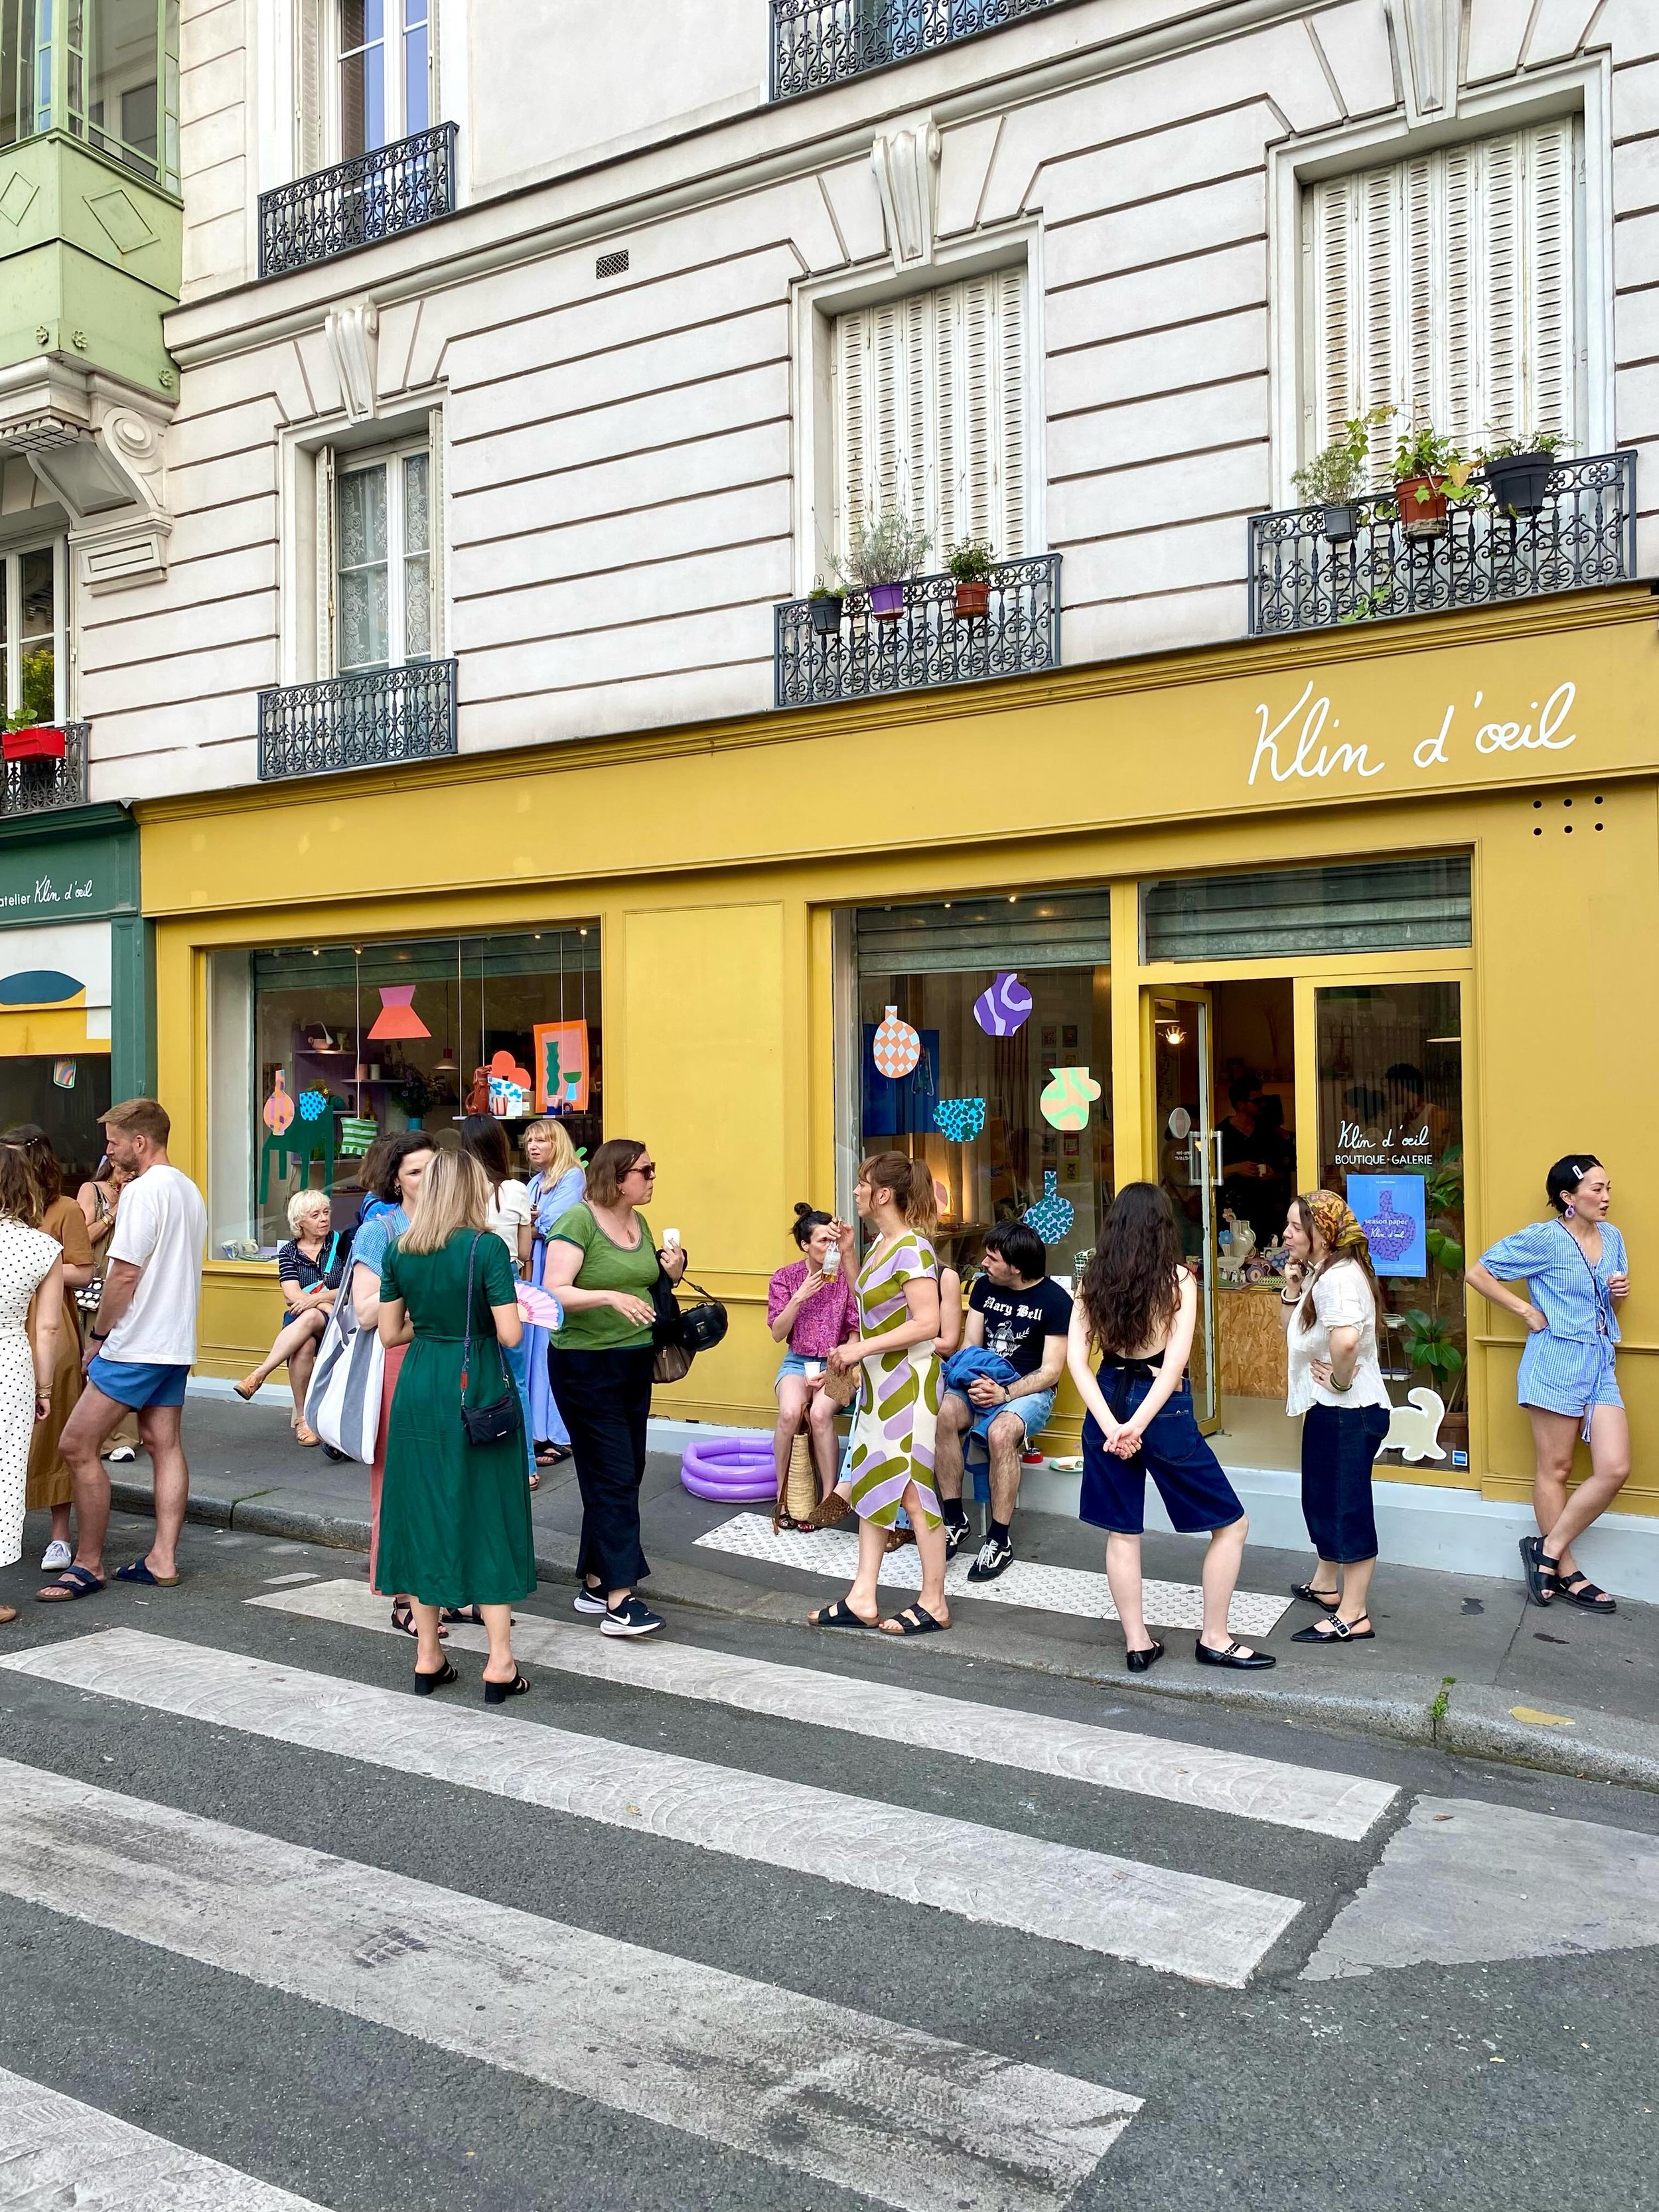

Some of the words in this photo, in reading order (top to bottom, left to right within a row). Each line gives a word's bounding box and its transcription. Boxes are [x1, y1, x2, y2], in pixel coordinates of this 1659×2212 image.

[1247, 680, 1386, 786] Klin
[0, 893, 31, 907] atelier
[34, 875, 60, 903] Klin
[1337, 1120, 1376, 1149] Klin
[1334, 1154, 1387, 1166] BOUTIQUE
[1391, 1154, 1433, 1165] GALERIE
[1016, 1304, 1043, 1321] Bell
